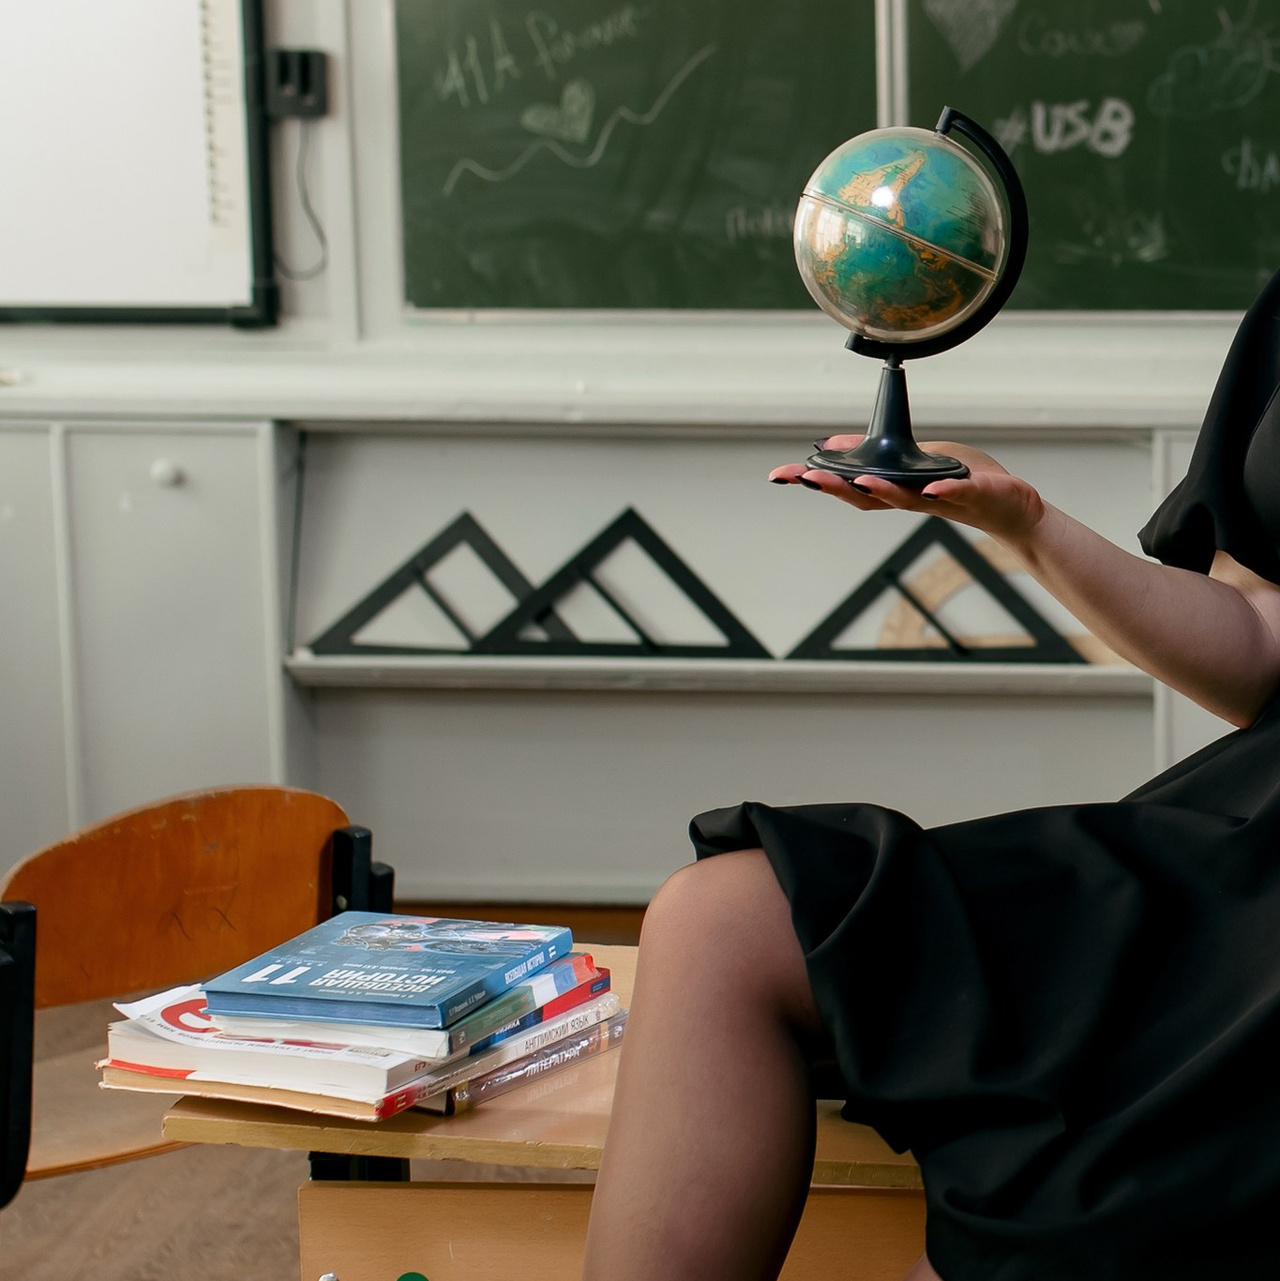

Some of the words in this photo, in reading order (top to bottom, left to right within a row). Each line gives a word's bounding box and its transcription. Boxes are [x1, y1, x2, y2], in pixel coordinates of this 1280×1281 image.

[240, 963, 311, 986] 11
[319, 968, 446, 986] ИСТОРИЯ
[307, 976, 432, 994] ВСЕОБЩАЯ
[524, 1022, 569, 1052] АНГЛИЙСКИЙ
[570, 1014, 589, 1031] ЯЗЫК
